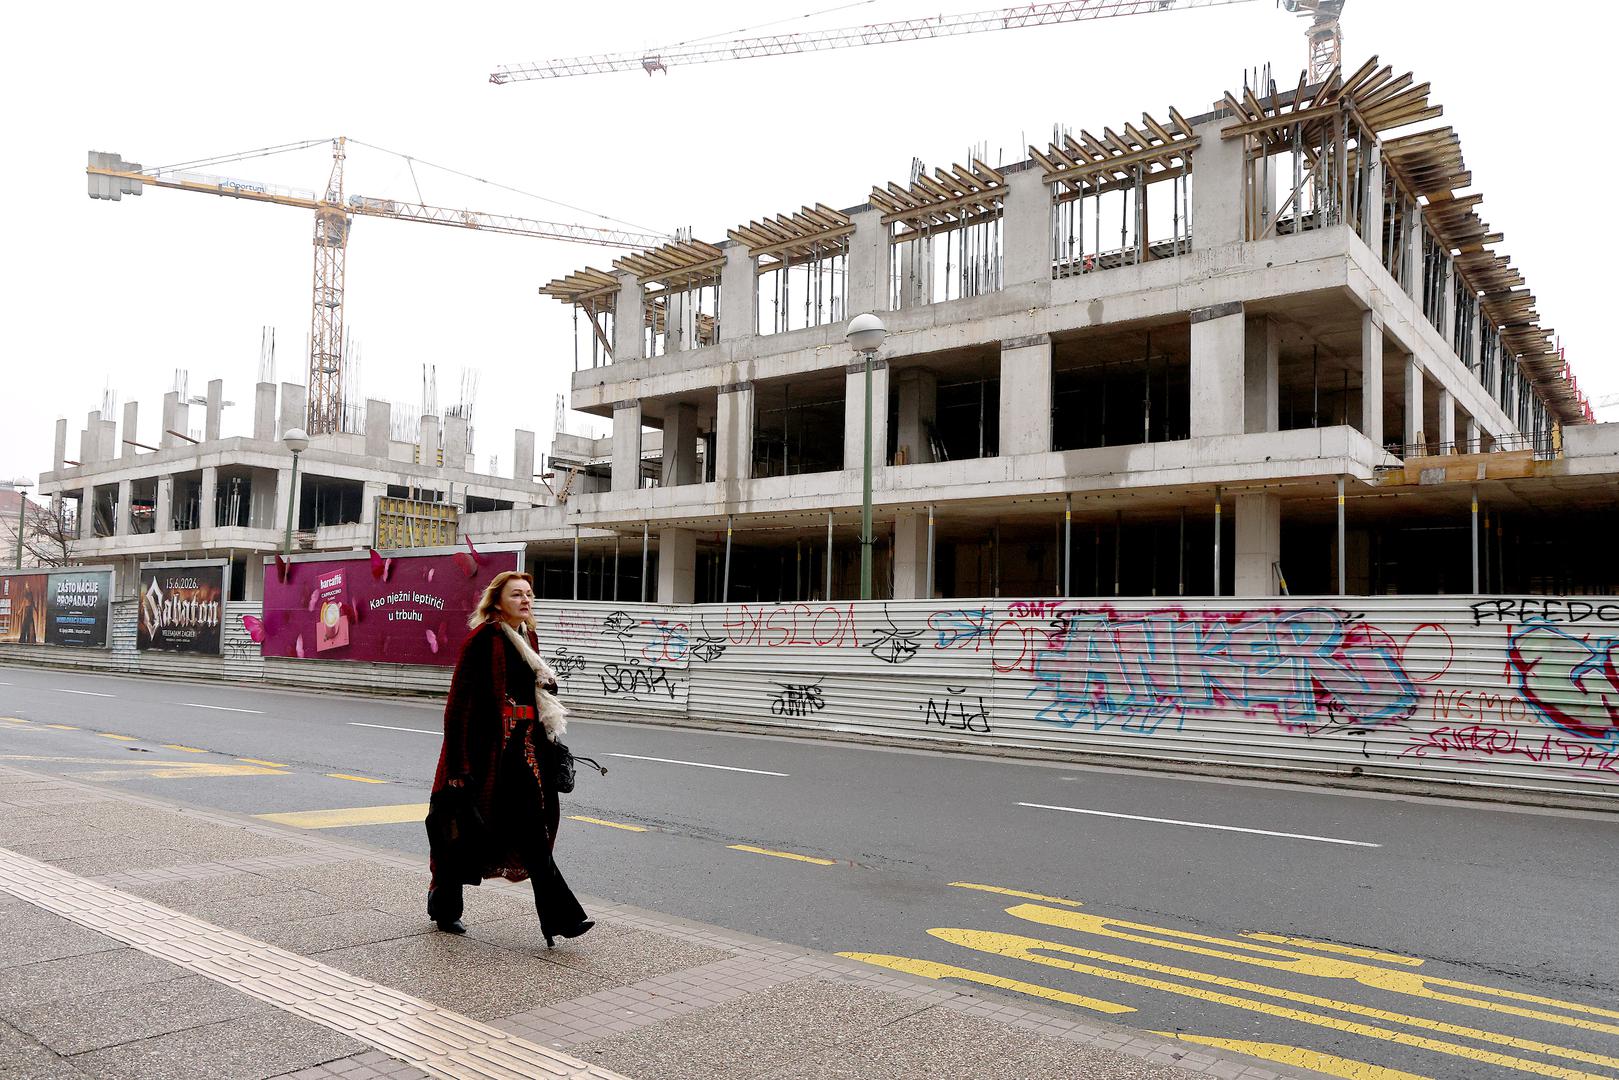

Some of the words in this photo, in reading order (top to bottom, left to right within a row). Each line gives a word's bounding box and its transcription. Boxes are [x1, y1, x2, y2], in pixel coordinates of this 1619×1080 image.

[166, 578, 199, 590] 15.6.2026.
[370, 598, 386, 611] Kao
[387, 591, 410, 605] nježni
[412, 592, 445, 612] leptirići
[388, 612, 394, 622] u
[395, 609, 422, 622] trbuhu
